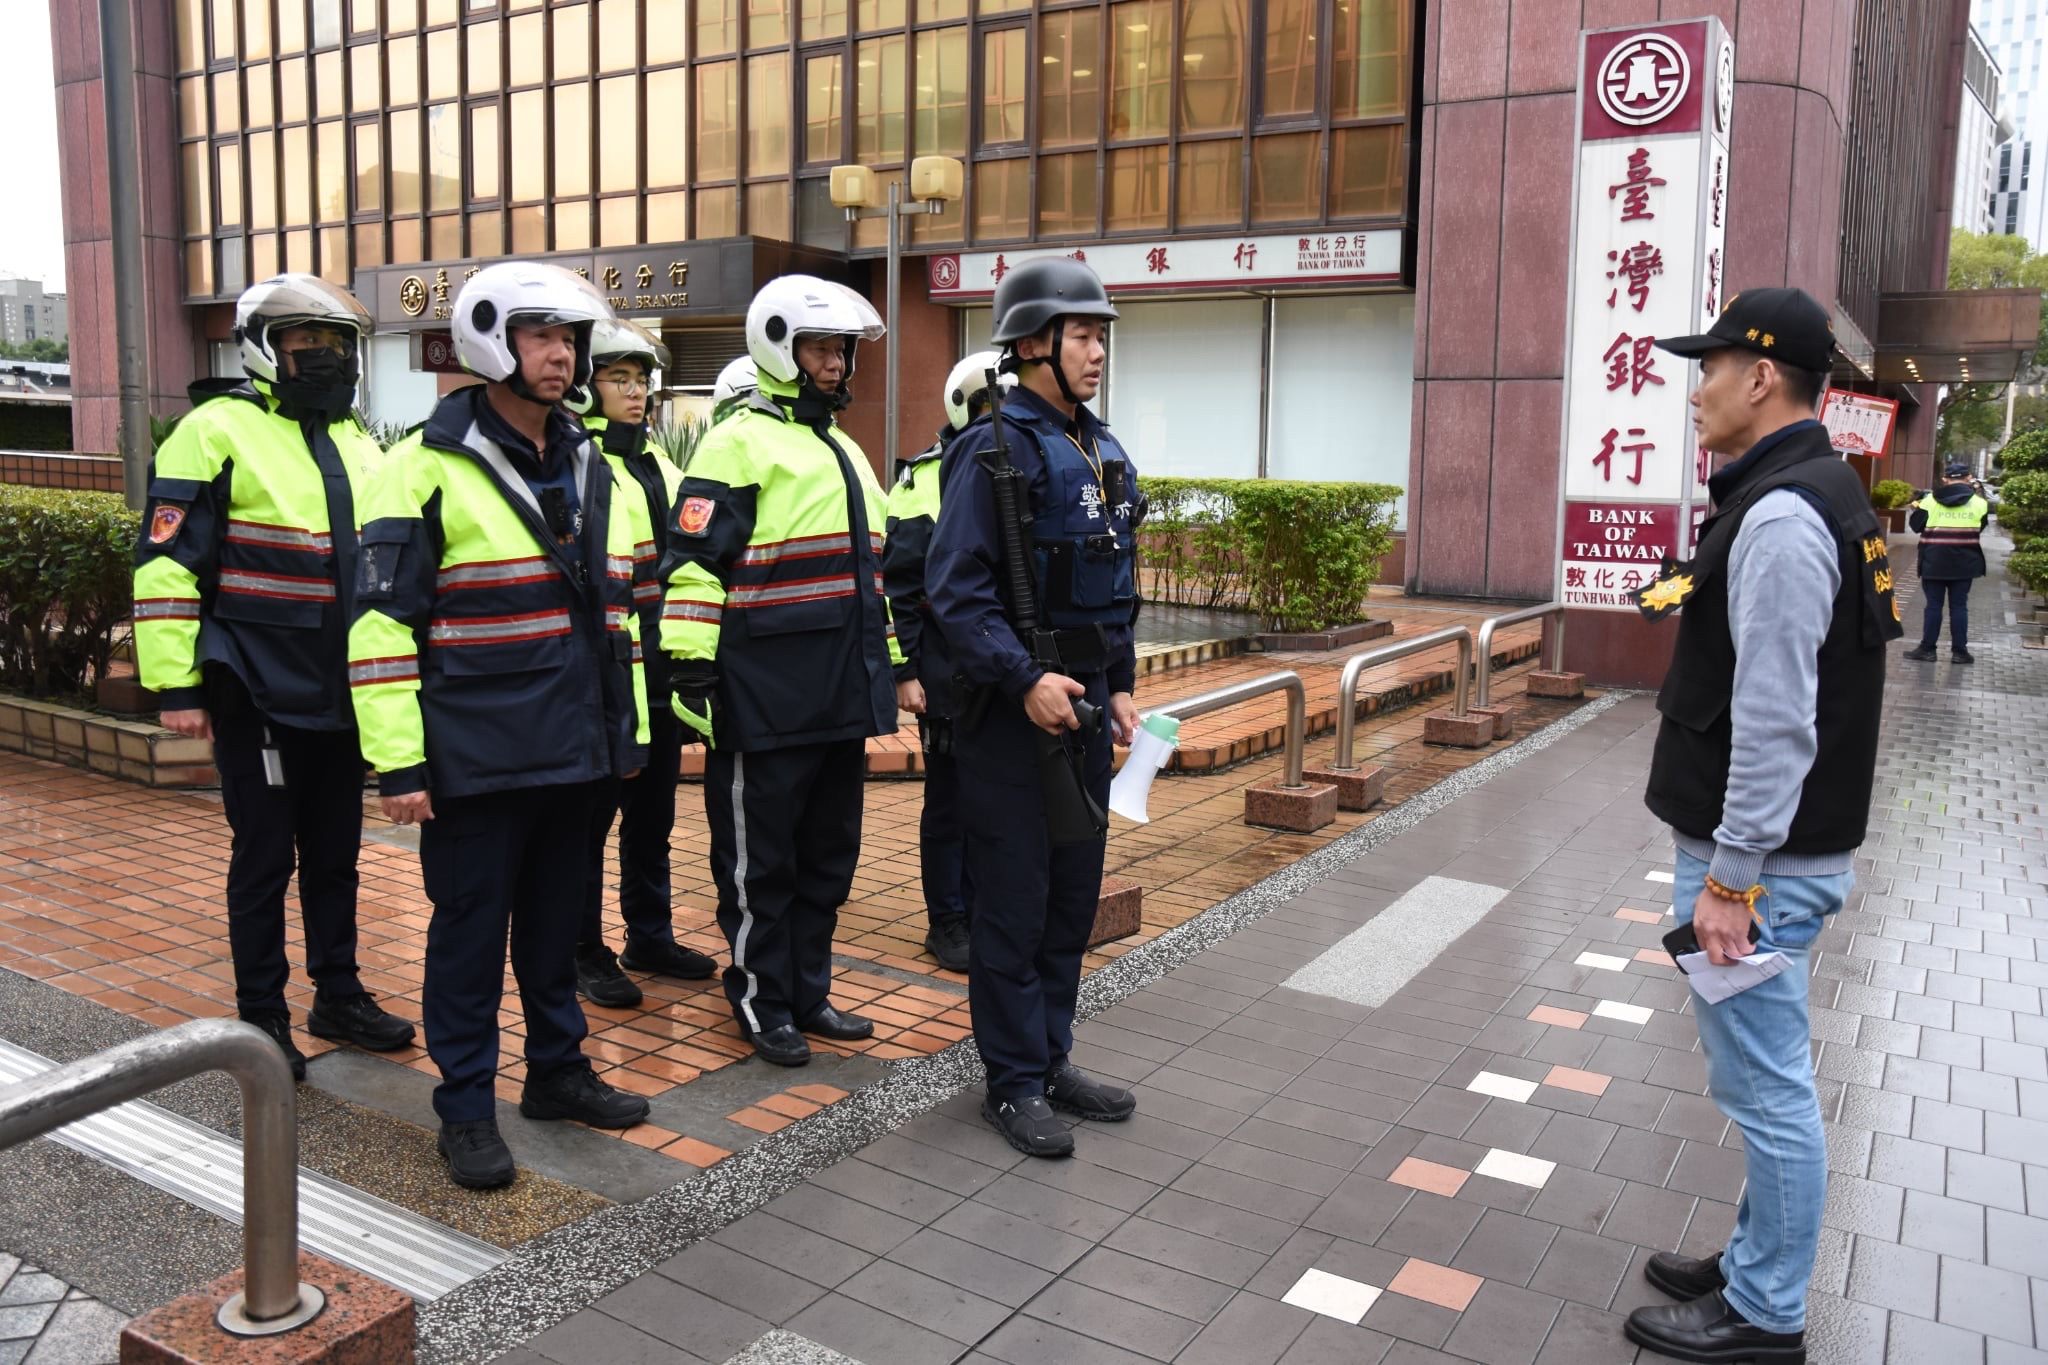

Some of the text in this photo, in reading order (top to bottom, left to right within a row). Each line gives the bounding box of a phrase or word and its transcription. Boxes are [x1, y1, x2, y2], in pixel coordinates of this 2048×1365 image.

[1298, 235, 1366, 251] 敦化分行
[1298, 249, 1366, 260] TUNHWA BRANCH
[1297, 258, 1365, 270] BANK OF TAIWAN
[635, 292, 689, 309] BRANCH
[1592, 147, 1667, 486] 臺灣銀行
[1588, 508, 1655, 525] BANK
[1938, 511, 1975, 520] POLICE
[1604, 527, 1636, 541] OF
[1573, 542, 1667, 560] TAIWAN
[1564, 591, 1615, 605] TUNHWA
